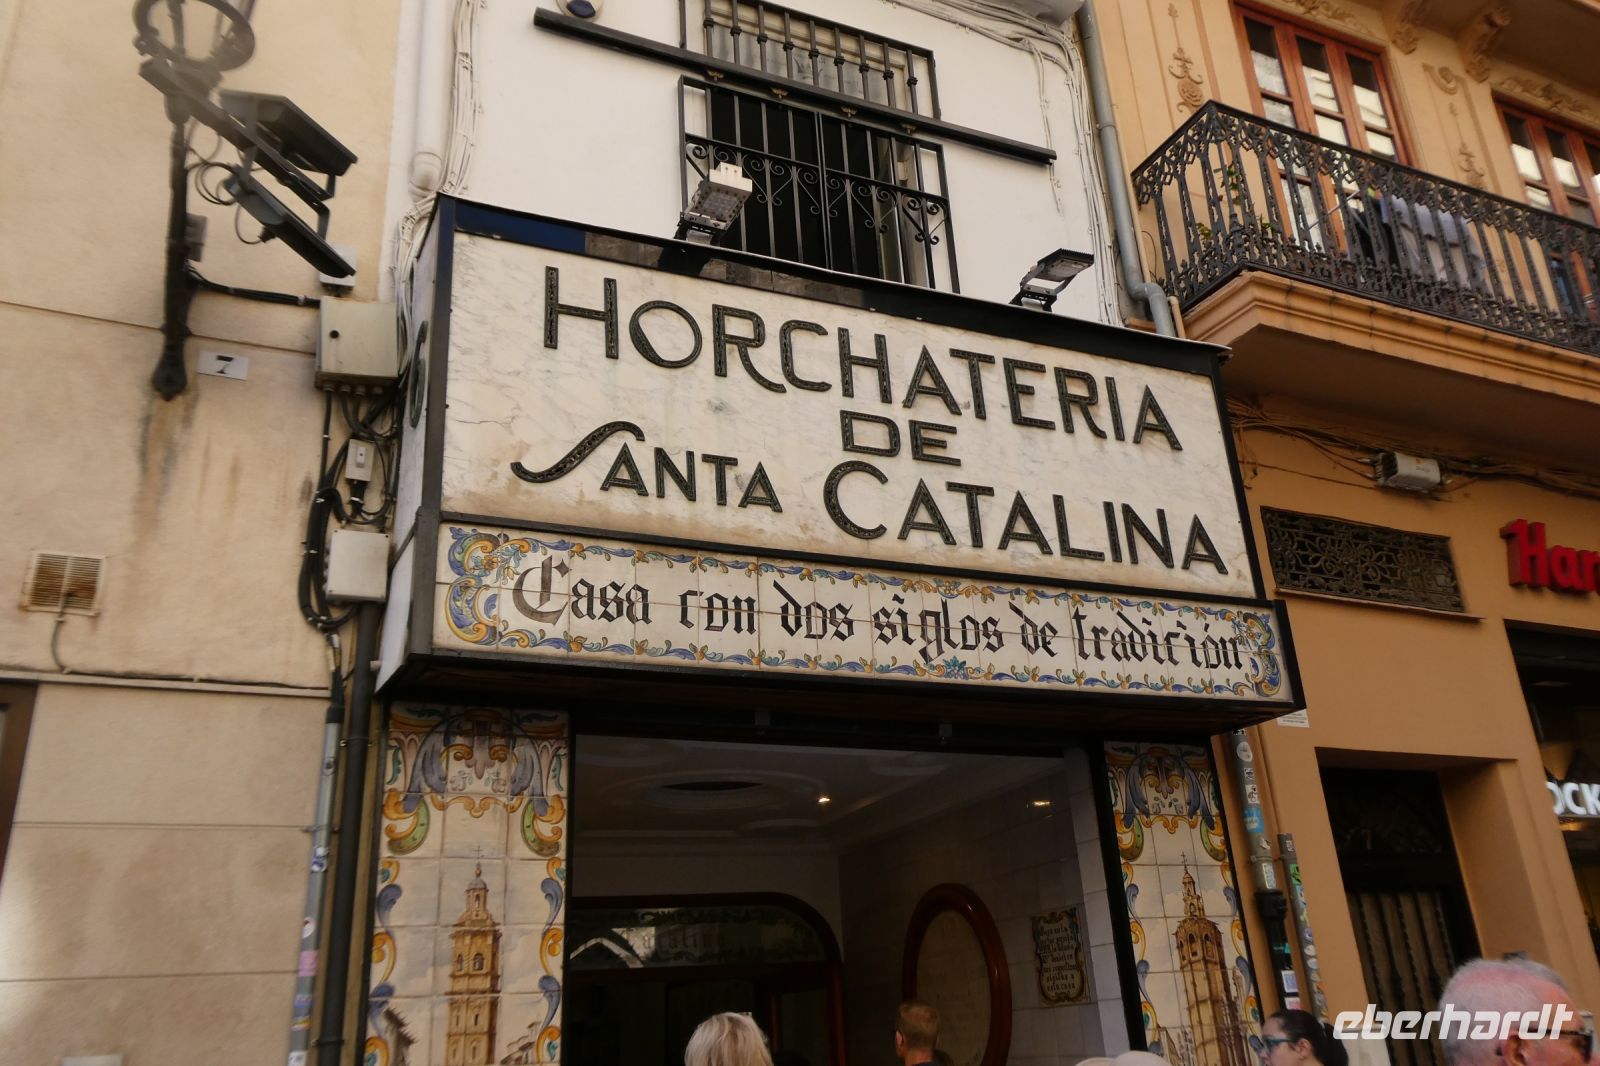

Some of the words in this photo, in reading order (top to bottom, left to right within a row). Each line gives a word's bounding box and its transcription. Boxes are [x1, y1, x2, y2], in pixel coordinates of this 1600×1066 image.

[215, 354, 234, 374] 7
[543, 265, 1184, 451] HORCHATERIA
[839, 409, 962, 466] DE
[510, 420, 783, 513] SANTA
[823, 460, 1229, 575] CATALINA
[511, 554, 653, 627] Casa
[678, 589, 757, 635] con
[772, 579, 854, 642] dos
[872, 593, 1005, 665] siglos
[1008, 600, 1059, 658] de
[1071, 606, 1244, 671] tradición
